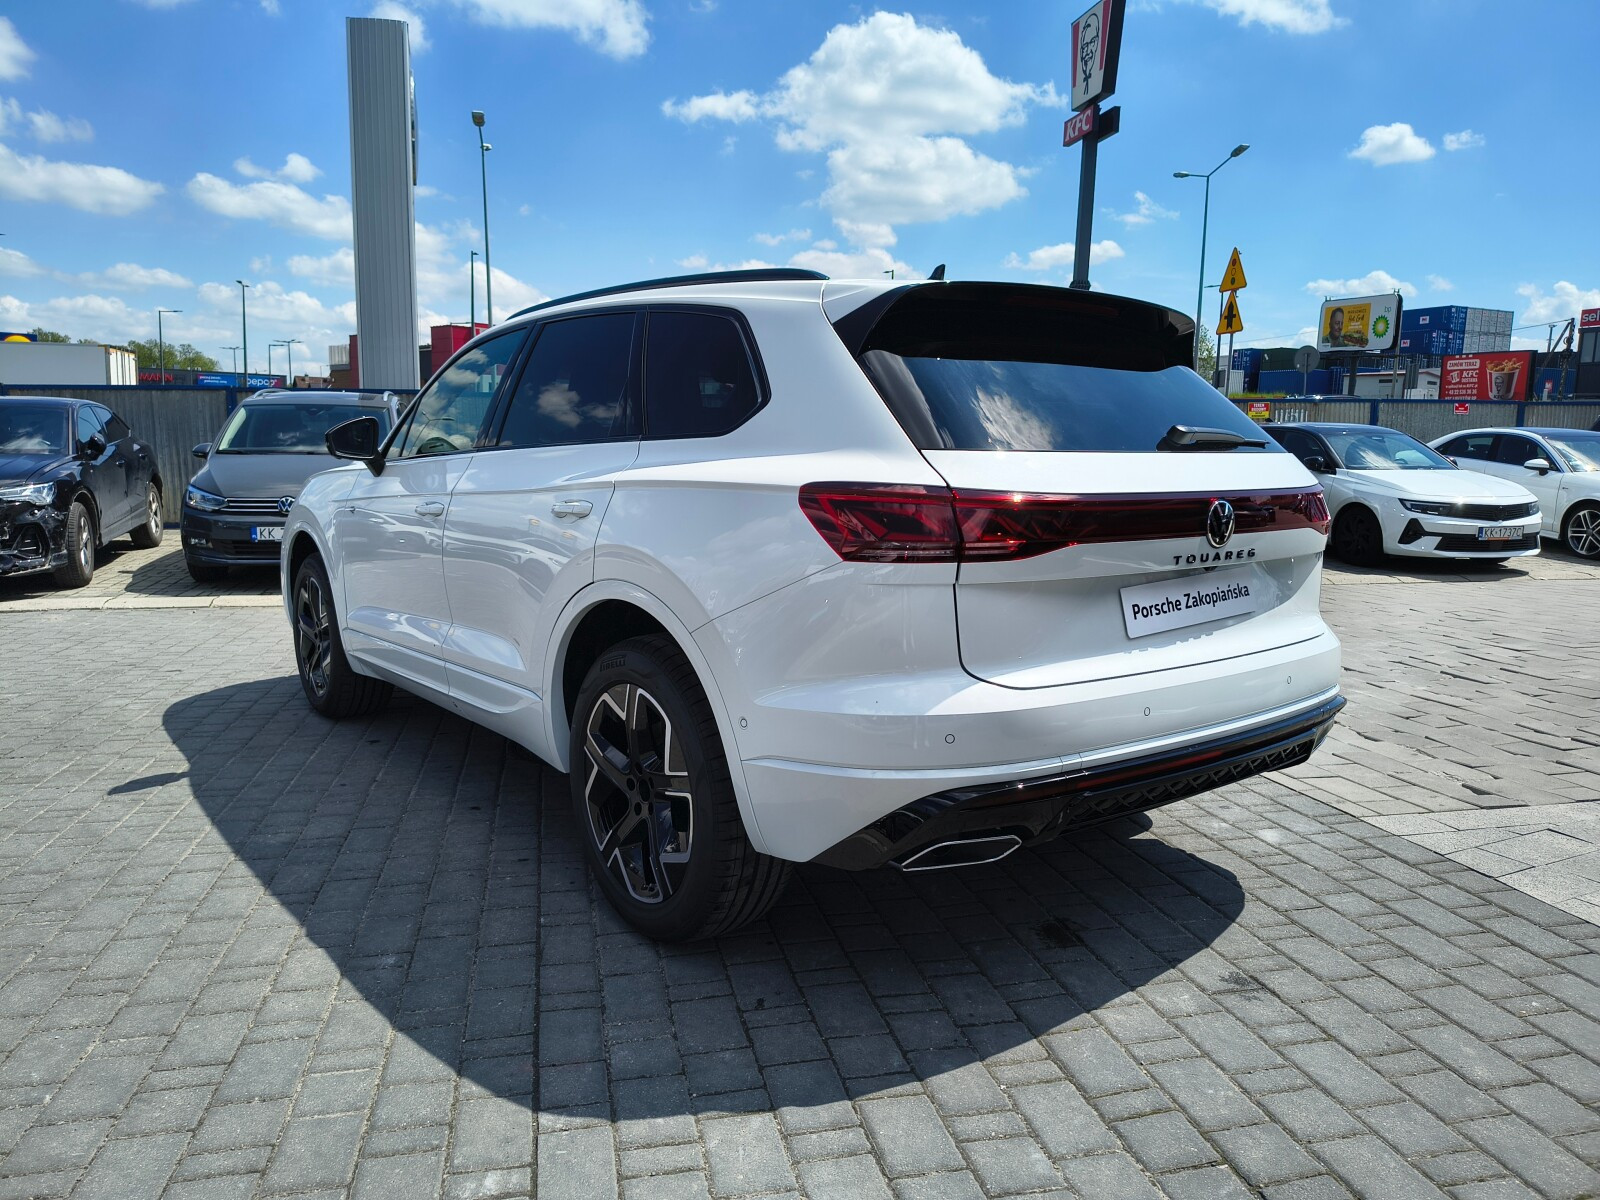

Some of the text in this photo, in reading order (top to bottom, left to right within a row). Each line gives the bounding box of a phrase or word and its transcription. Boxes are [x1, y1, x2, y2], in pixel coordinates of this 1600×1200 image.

[1064, 109, 1091, 142] KFC
[1384, 305, 1392, 314] bp
[1461, 370, 1479, 378] KFC
[259, 527, 275, 539] KK
[1173, 548, 1256, 566] TOUAREG
[1131, 583, 1250, 620] Porsche Zakopiańska
